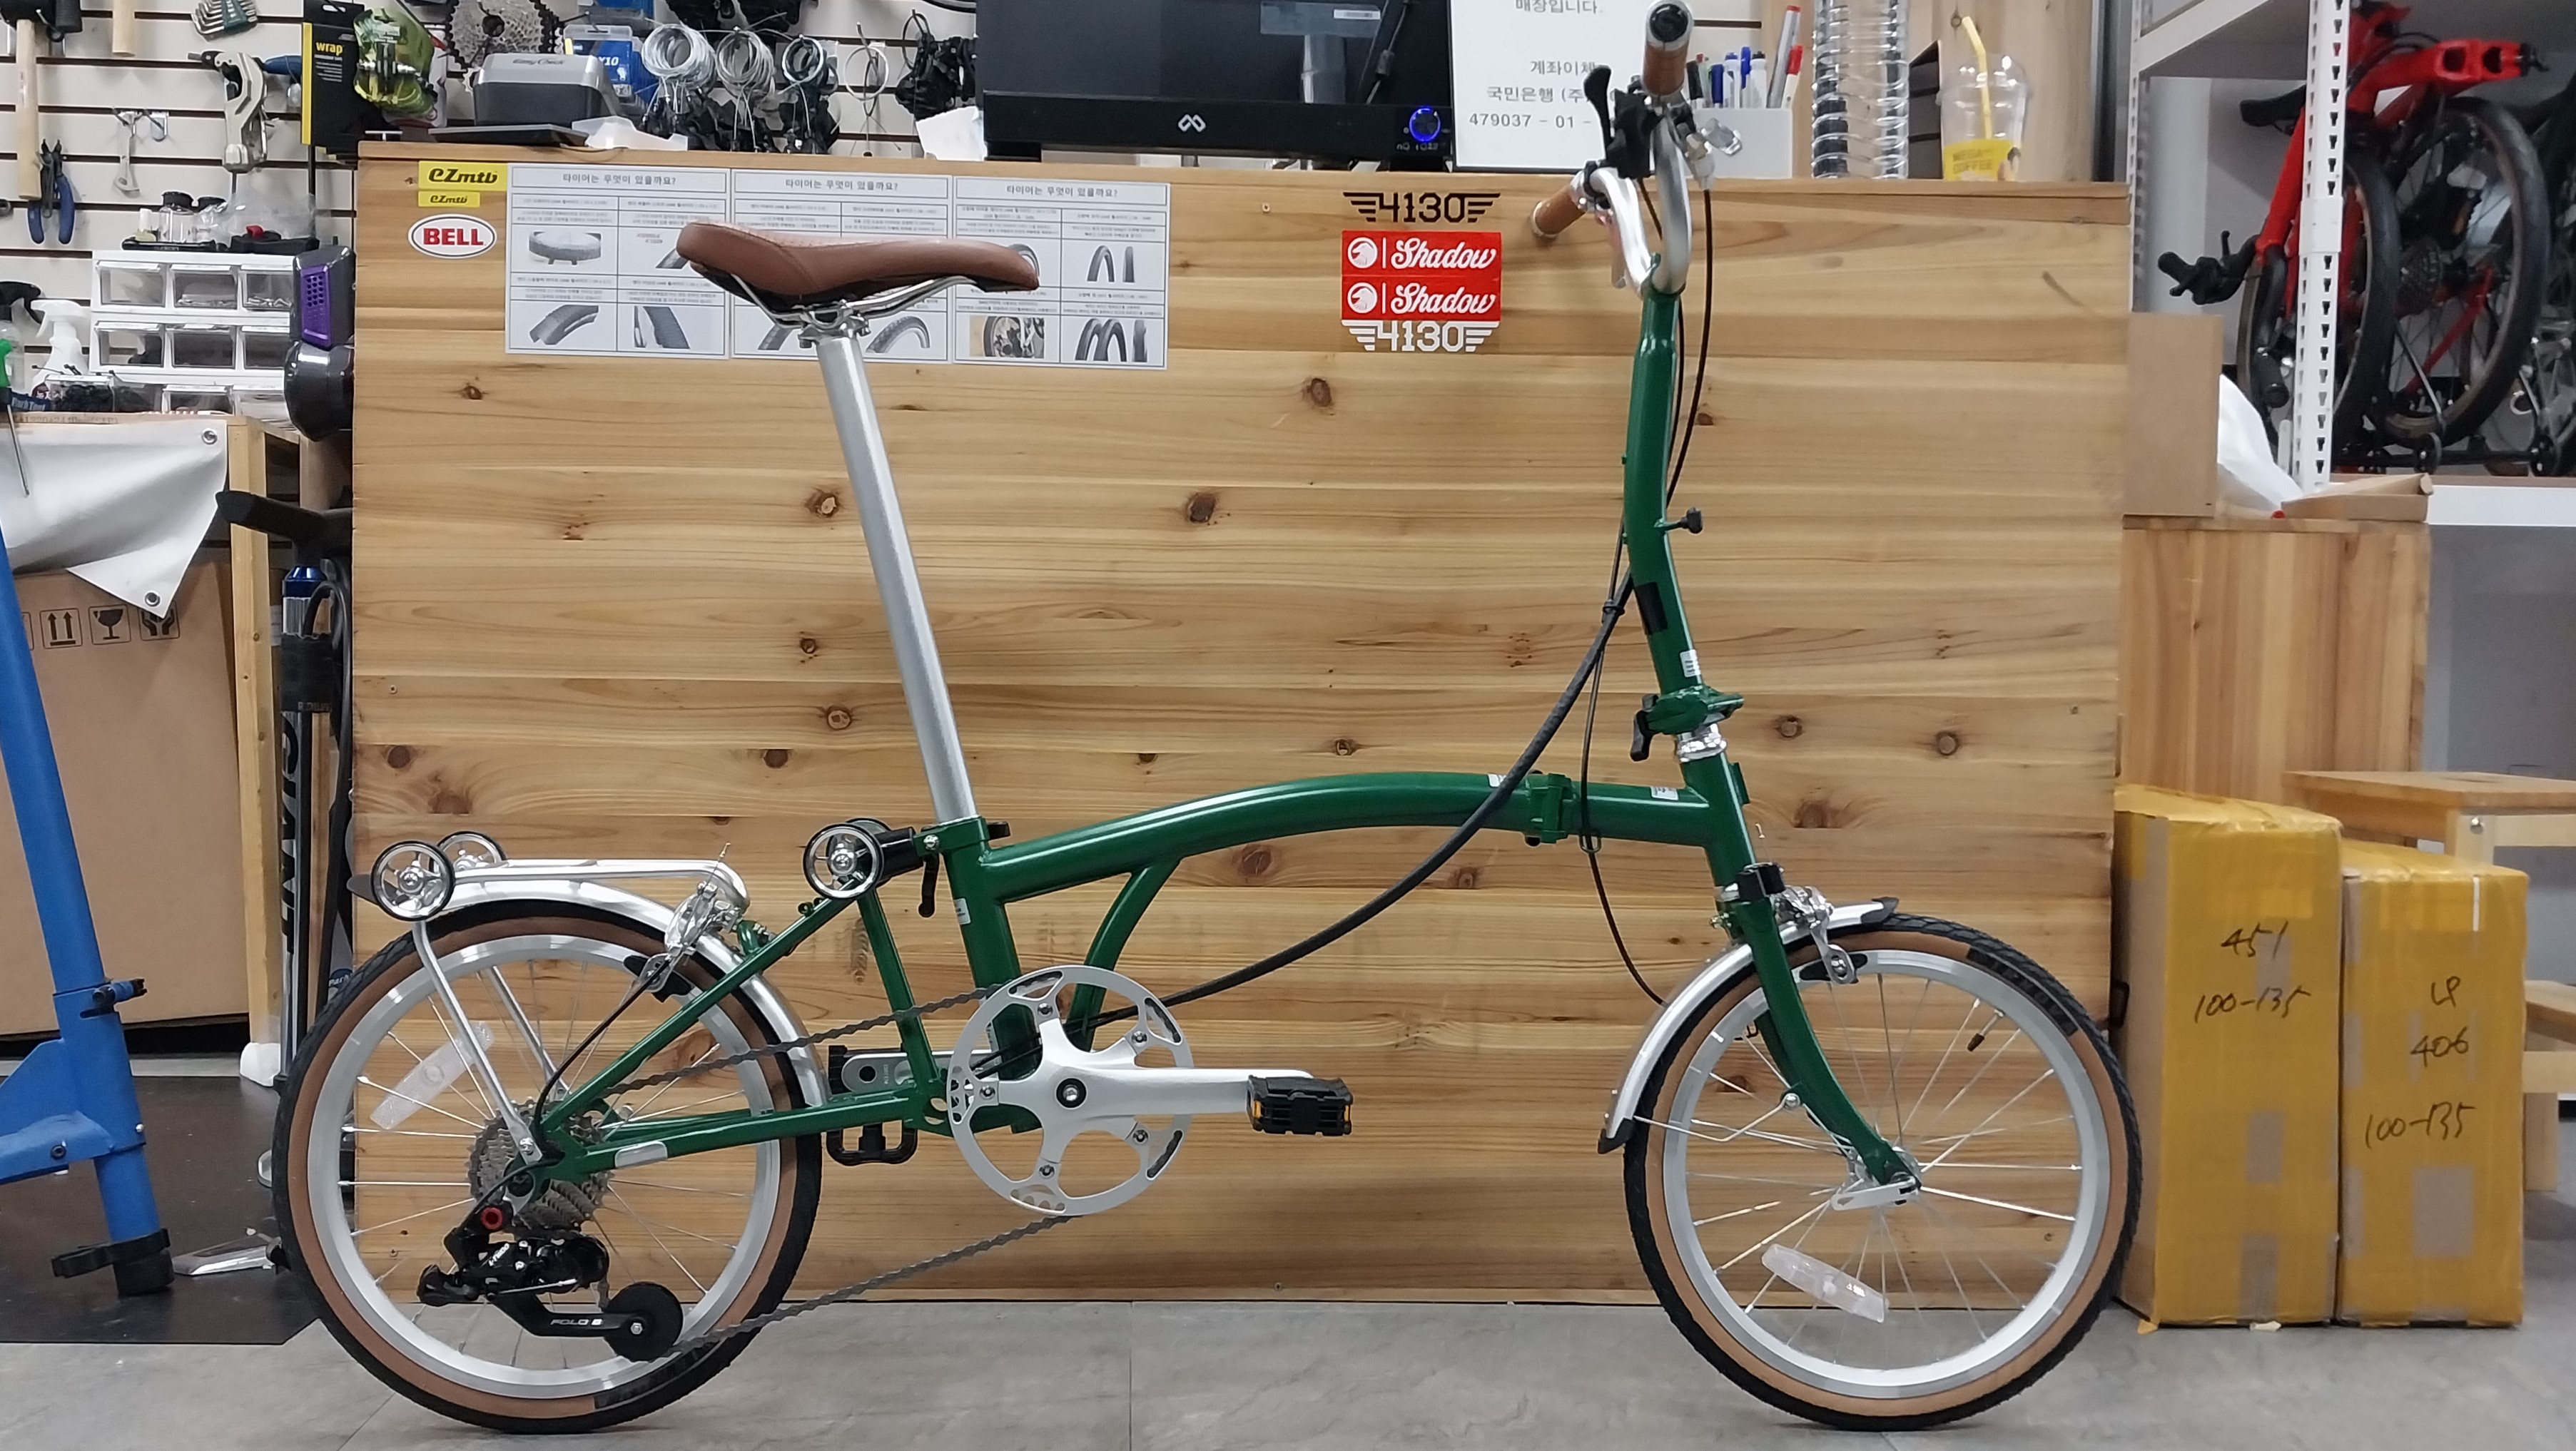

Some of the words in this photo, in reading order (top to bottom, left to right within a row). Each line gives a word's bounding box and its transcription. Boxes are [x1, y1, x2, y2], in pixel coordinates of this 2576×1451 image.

[315, 42, 343, 56] wrap
[1486, 86, 1554, 103] 국민은행
[1469, 113, 1532, 127] 479037
[1555, 115, 1575, 129] 01
[562, 173, 599, 184] 타이어는
[604, 174, 631, 185] 무엇이
[634, 175, 676, 185] 있을까요?
[785, 179, 822, 189] 타이어는
[826, 180, 853, 190] 무엇이
[857, 180, 898, 191] 있을까요?
[1006, 185, 1043, 195] 타이어는
[1048, 186, 1073, 197] 무엇이
[1077, 187, 1118, 198] 있을까요?
[423, 228, 484, 245] BELL
[1391, 237, 1497, 270] Shadow
[1391, 282, 1496, 315] Shadow
[2221, 920, 2288, 959] 451
[2194, 985, 2312, 1024] 100-135
[2409, 1026, 2470, 1068] 406
[2365, 1101, 2476, 1149] 100-135
